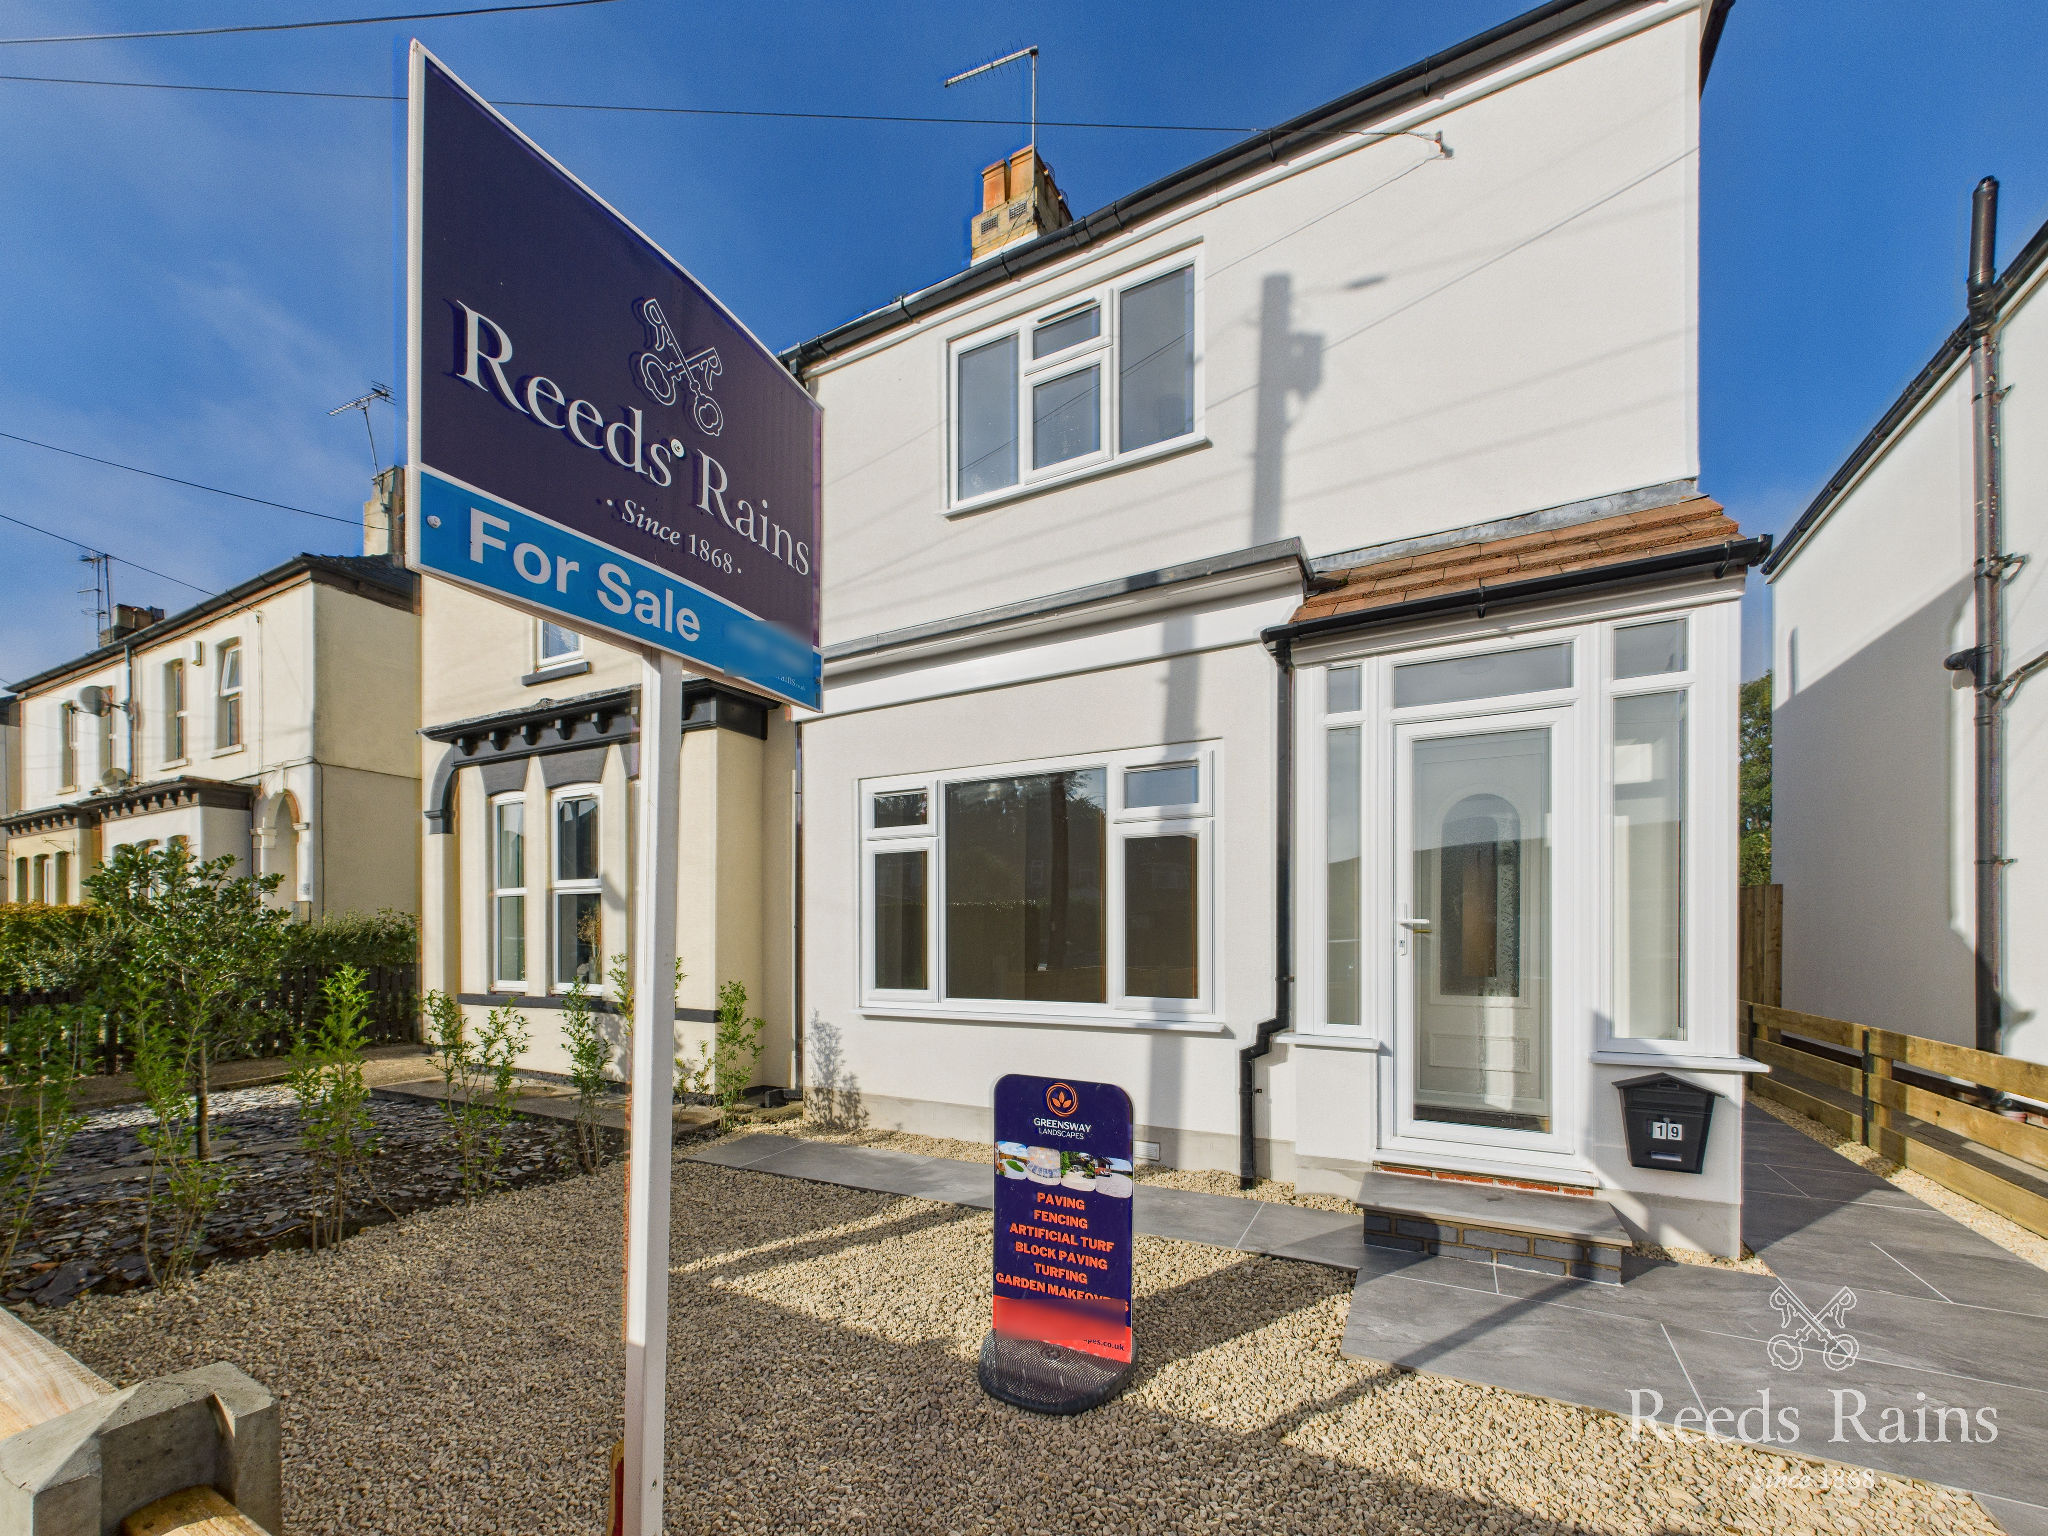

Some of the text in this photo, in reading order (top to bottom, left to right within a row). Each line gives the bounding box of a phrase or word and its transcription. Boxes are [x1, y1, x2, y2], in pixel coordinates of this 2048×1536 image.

[456, 299, 810, 577] Reeds Rains
[621, 499, 733, 574] Since 1868
[469, 507, 701, 642] For Sale
[1033, 1117, 1092, 1133] GREENSWAY
[1038, 1127, 1085, 1140] LANDSCAPES
[1656, 1125, 1679, 1138] 19
[1036, 1191, 1086, 1211] PAVING
[1033, 1209, 1088, 1230] FENCING
[1009, 1222, 1115, 1253] ARTIFICIAL TURF
[1015, 1241, 1108, 1271] BLOCK PAVING
[995, 1272, 1046, 1293] GARDEN
[1033, 1262, 1088, 1285] TURFING
